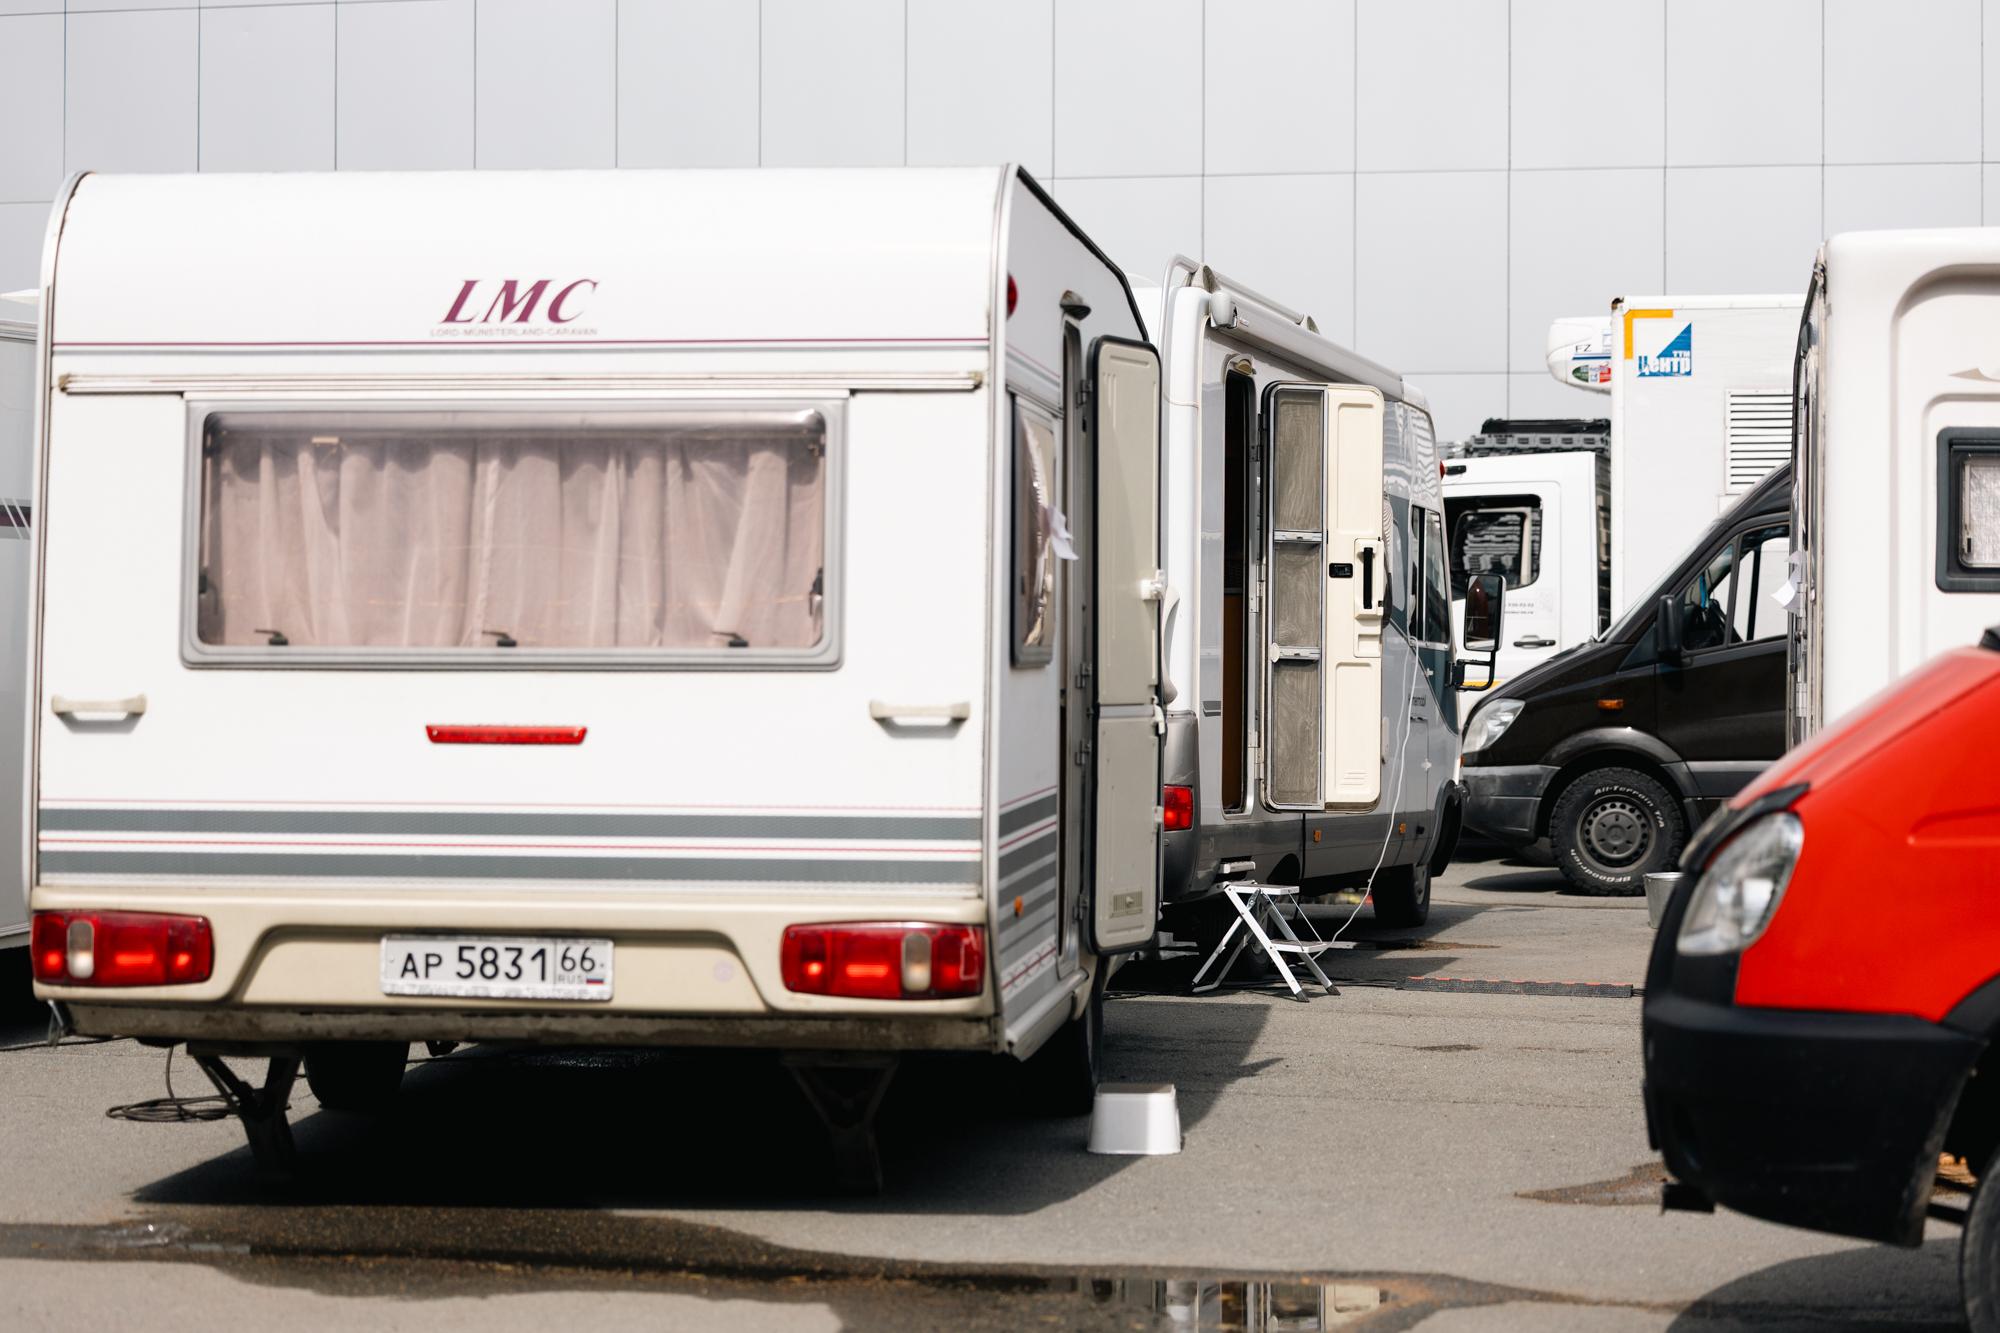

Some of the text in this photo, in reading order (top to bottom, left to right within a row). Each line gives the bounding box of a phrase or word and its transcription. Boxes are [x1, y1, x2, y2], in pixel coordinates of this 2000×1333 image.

[440, 278, 600, 324] LMC
[1593, 785, 1665, 828] All-Terrain T/A
[1570, 848, 1632, 883] BFGoodrich
[456, 946, 546, 981] 5831
[560, 946, 596, 972] 66
[558, 974, 584, 983] RUS
